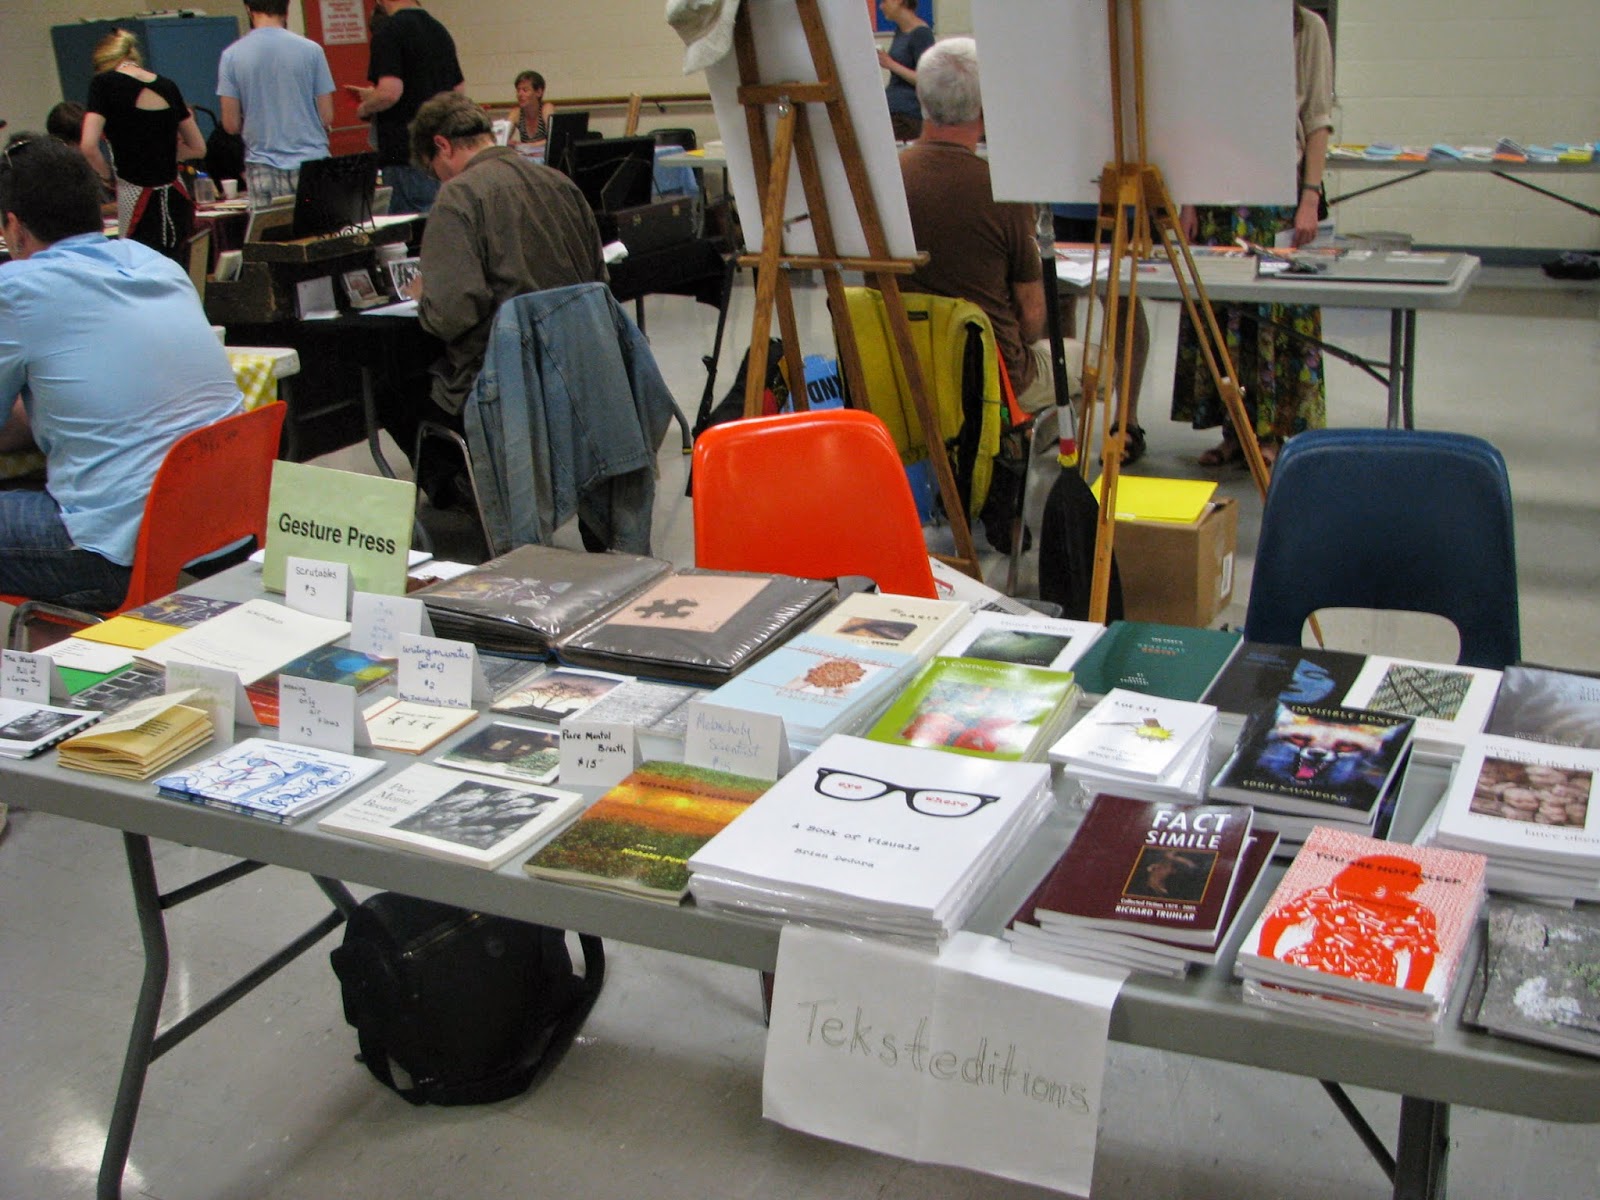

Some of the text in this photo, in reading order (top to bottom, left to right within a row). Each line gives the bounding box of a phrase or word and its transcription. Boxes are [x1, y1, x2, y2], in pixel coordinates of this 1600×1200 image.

[278, 513, 396, 555] Gesture Press
[1291, 705, 1355, 720] INVISIBLE
[562, 729, 611, 741] Pure Mental
[597, 744, 627, 754] Breath
[838, 780, 863, 791] eye
[925, 795, 969, 808] where
[1151, 810, 1232, 833] FACT
[792, 822, 921, 852] A Book of Visuals
[1145, 830, 1222, 850] SIMILE
[1316, 852, 1462, 884] YOU ARE NOT ASLEEP
[1115, 904, 1196, 921] RICHARD TRUHLAR
[798, 1000, 1090, 1113] Teksteditions
